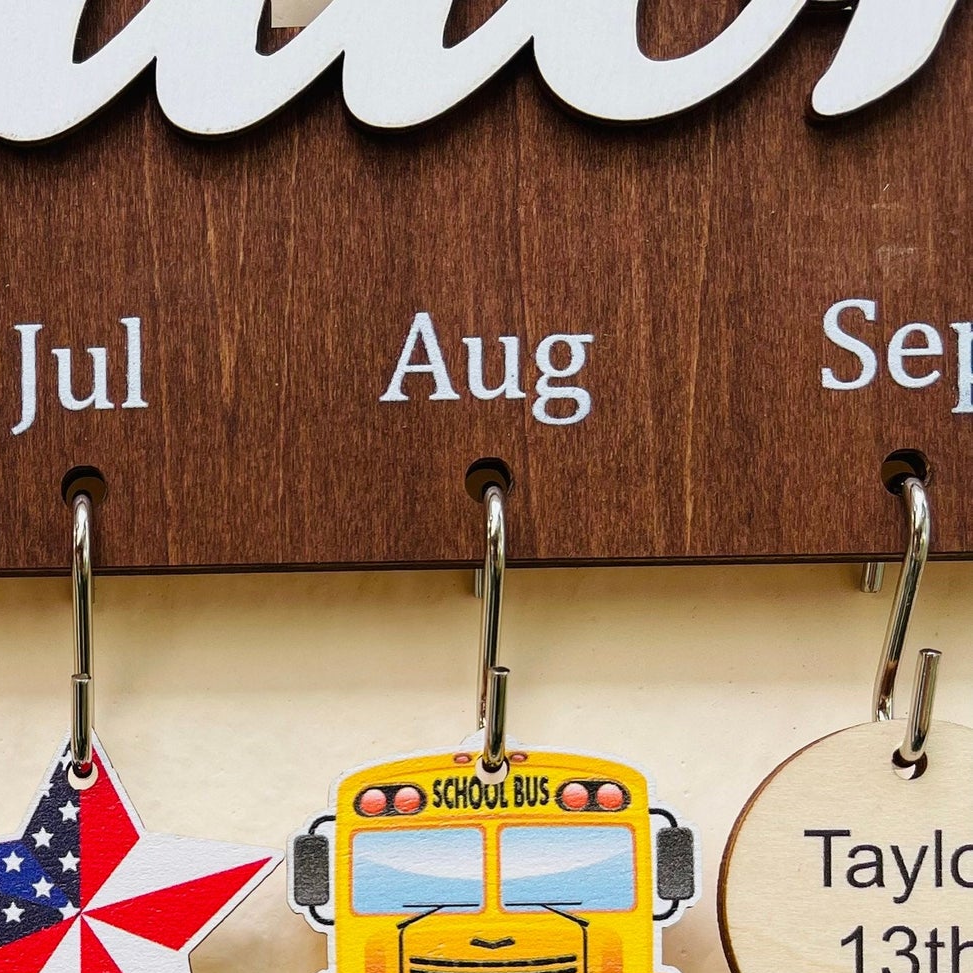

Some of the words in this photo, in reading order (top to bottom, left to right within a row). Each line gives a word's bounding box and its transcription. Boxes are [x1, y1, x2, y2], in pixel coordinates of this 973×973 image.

[11, 317, 149, 436] Jul
[380, 312, 594, 426] Aug
[432, 776, 509, 809] SCHOOL
[514, 775, 549, 807] BUS
